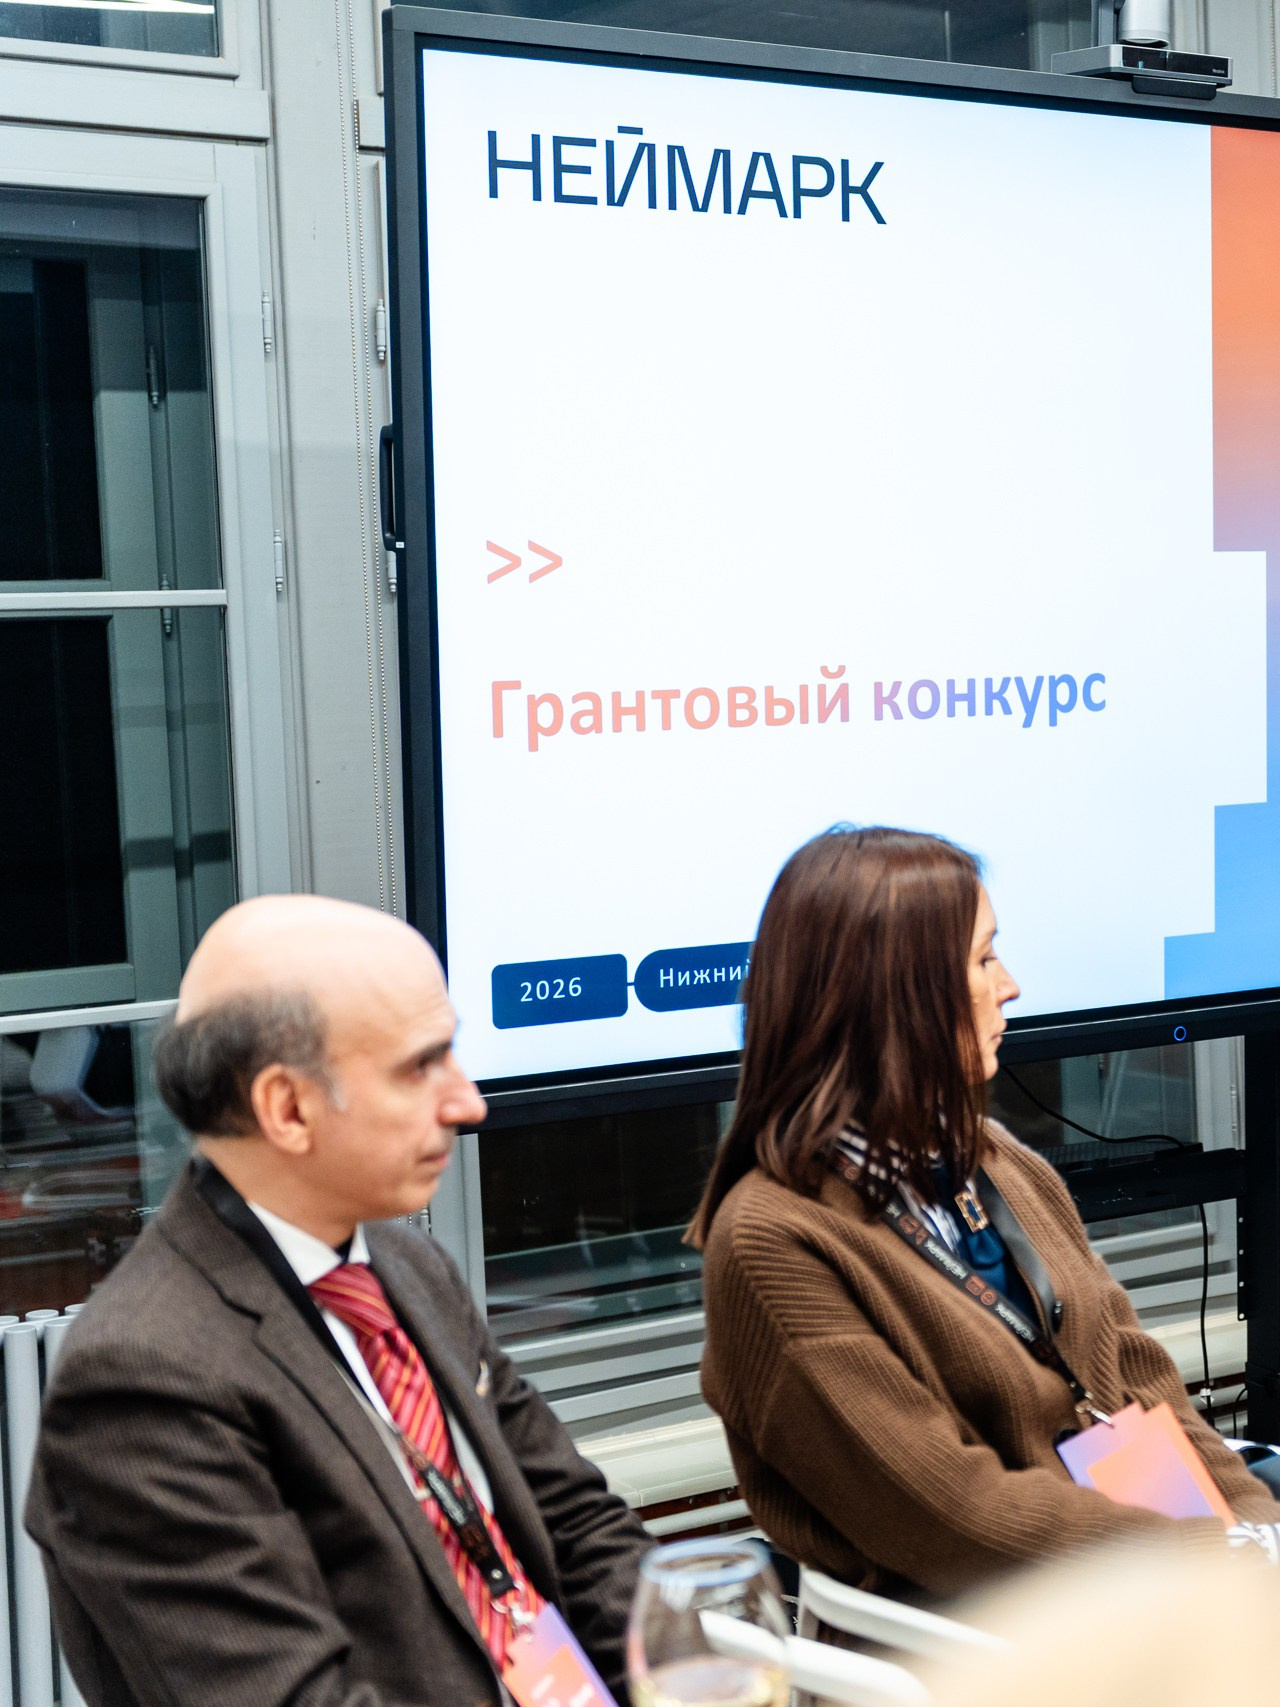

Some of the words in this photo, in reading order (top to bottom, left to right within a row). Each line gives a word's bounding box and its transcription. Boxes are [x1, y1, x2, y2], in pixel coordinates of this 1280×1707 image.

[487, 125, 888, 225] НЕЙМАРК
[491, 664, 851, 753] Грантовый
[873, 671, 1107, 730] конкурс
[520, 976, 582, 1002] 2026
